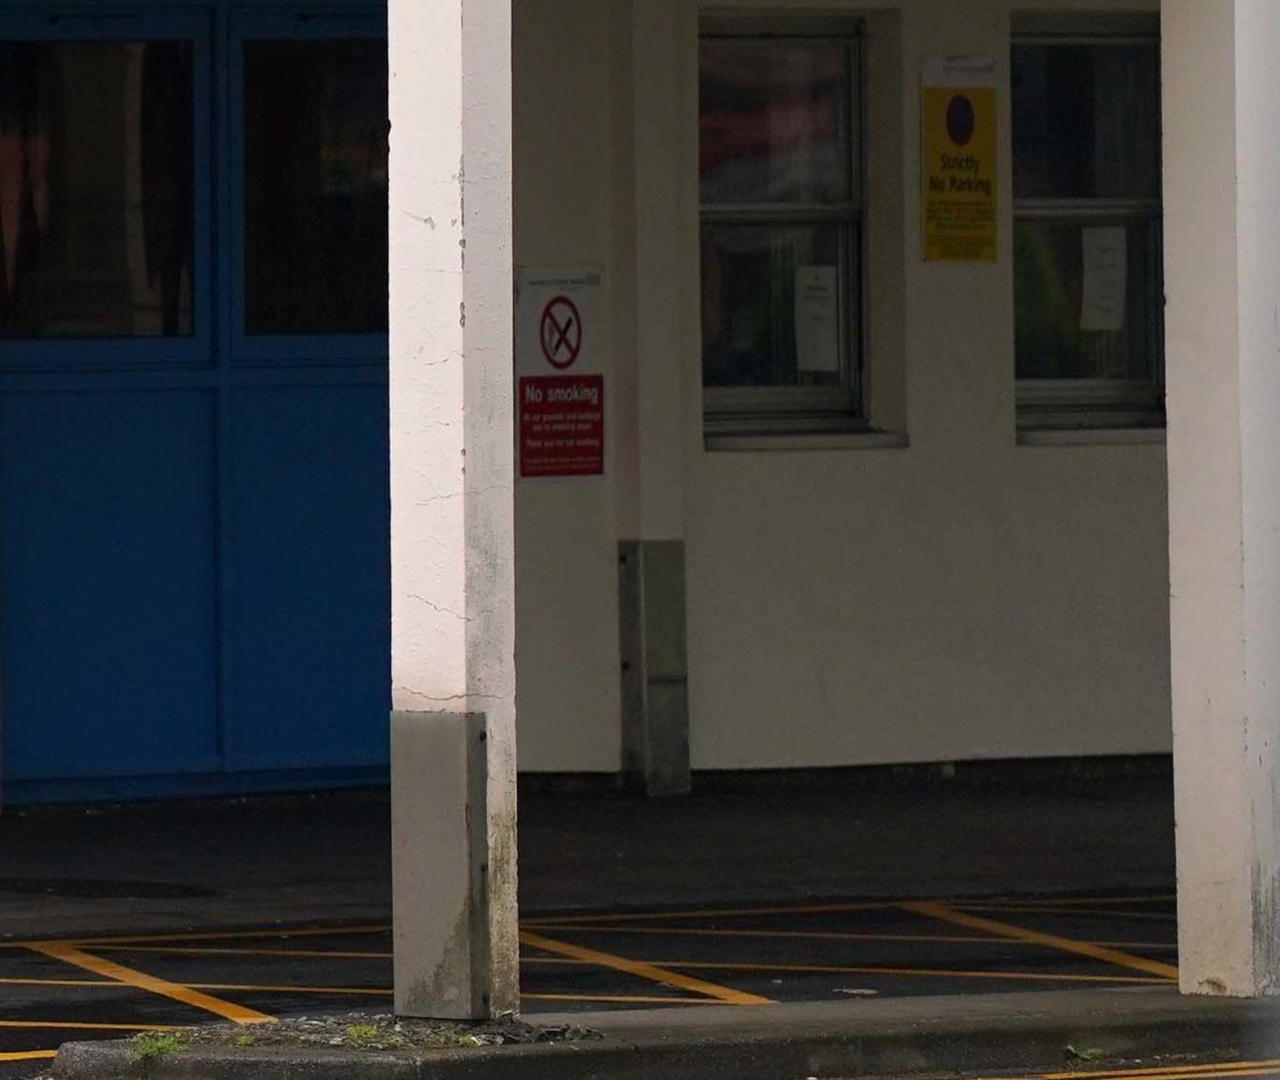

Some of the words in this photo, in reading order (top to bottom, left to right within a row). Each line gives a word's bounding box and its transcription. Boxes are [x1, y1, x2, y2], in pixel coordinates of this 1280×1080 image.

[940, 153, 979, 176] Strictly
[929, 175, 945, 191] No
[950, 175, 992, 198] Parking
[525, 384, 542, 403] No
[547, 383, 598, 405] smoking
